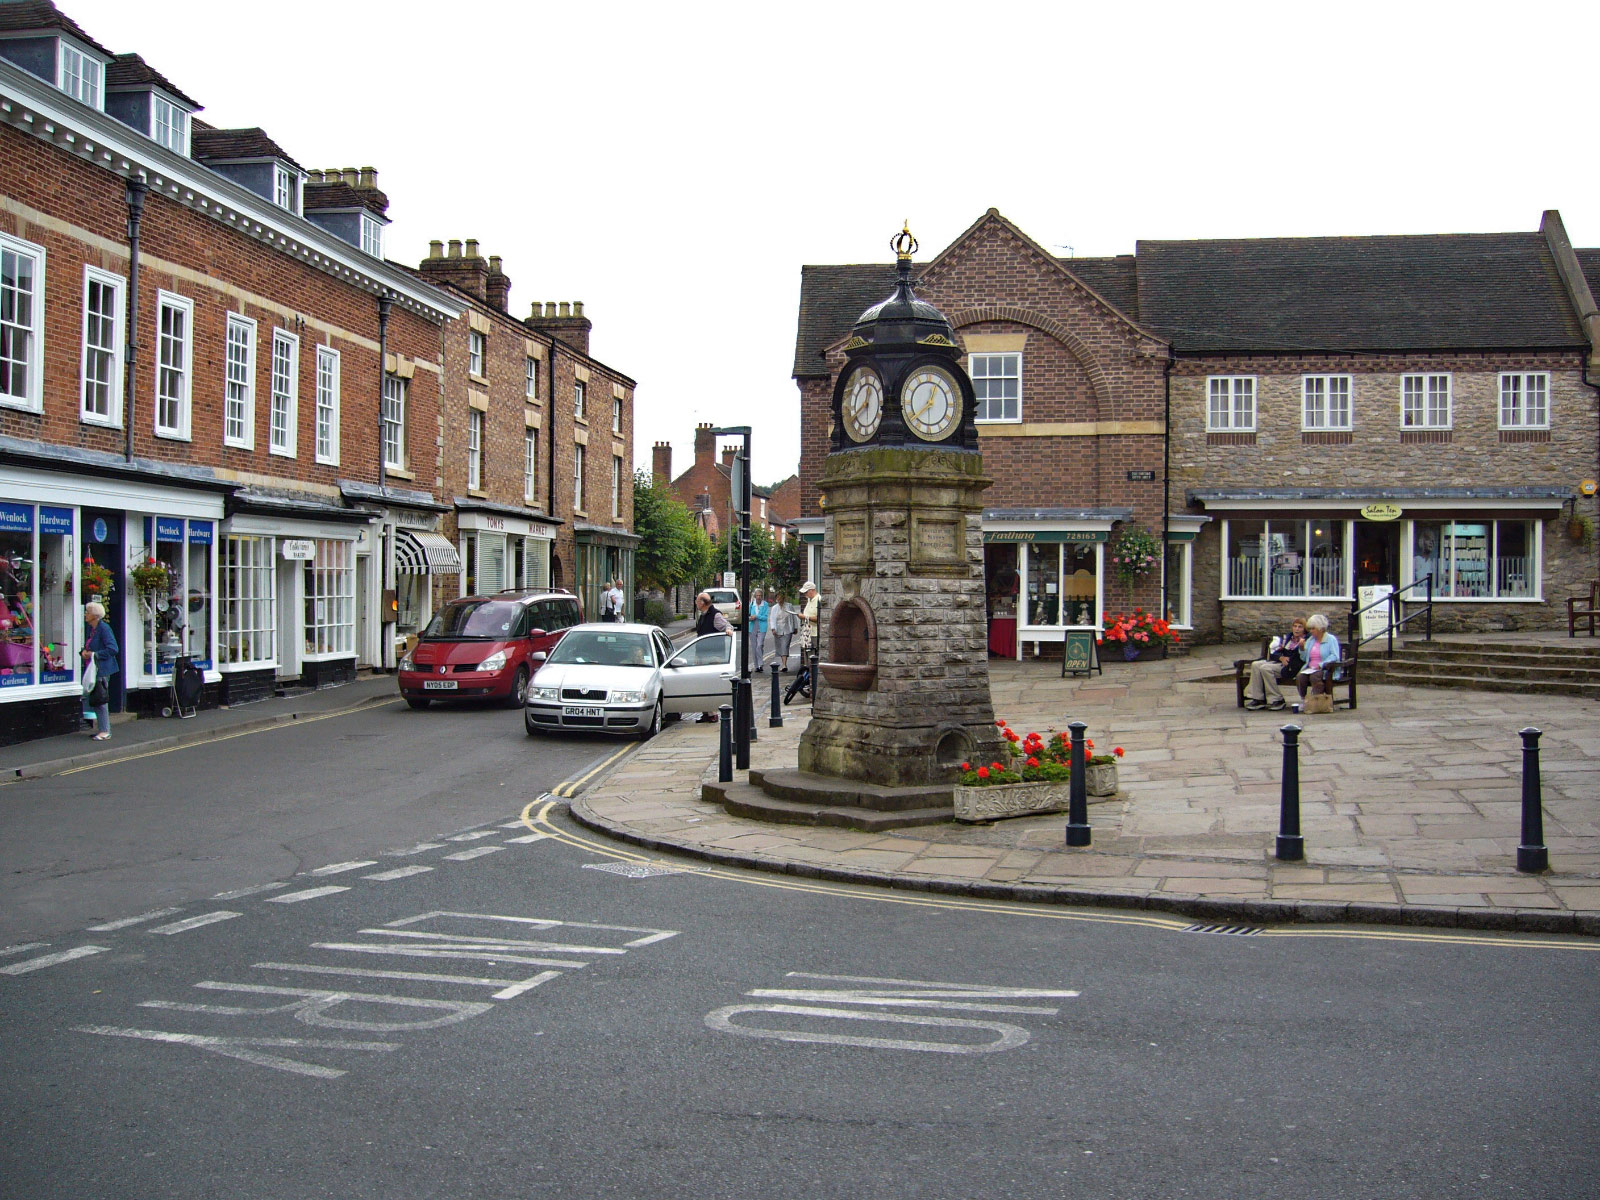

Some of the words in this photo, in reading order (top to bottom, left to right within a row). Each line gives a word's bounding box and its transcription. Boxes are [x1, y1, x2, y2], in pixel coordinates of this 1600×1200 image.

[1366, 505, 1384, 514] Salon
[0, 511, 27, 523] Wenlock
[40, 514, 70, 526] Hardware
[159, 525, 180, 536] Wenlock
[188, 528, 211, 538] Hardware
[1066, 660, 1087, 668] OPEN
[1, 677, 28, 686] Gardening
[43, 674, 67, 683] Hardware
[565, 707, 584, 715] GR04
[586, 708, 600, 716] HNT
[68, 911, 682, 1079] ENTRY
[704, 971, 1081, 1054] NO
